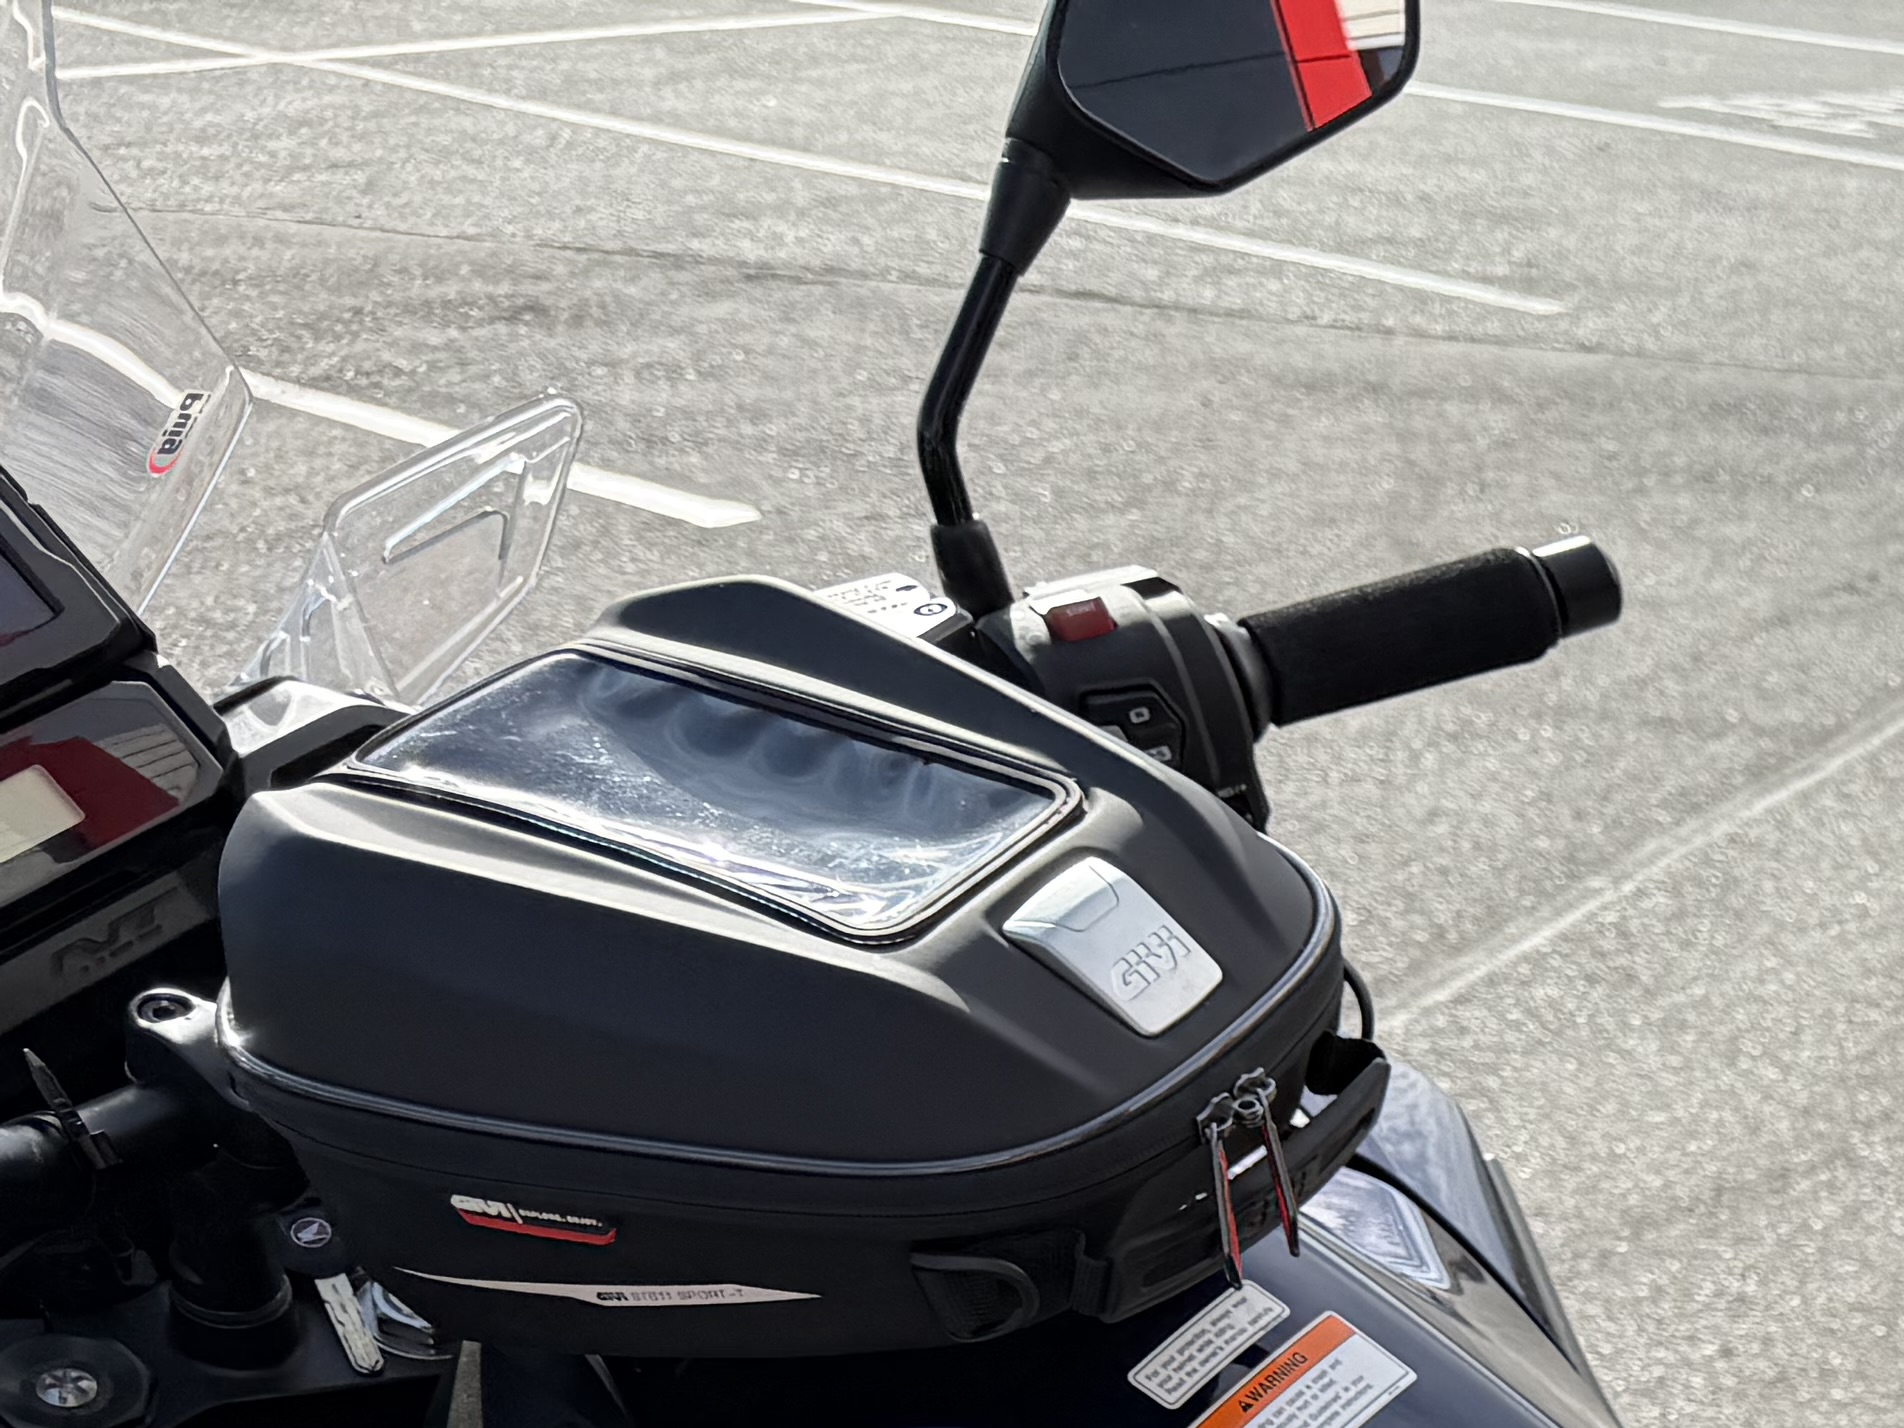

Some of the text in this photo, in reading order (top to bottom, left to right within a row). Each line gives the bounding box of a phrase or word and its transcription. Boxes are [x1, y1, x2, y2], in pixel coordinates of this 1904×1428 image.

[1111, 924, 1192, 1001] GIVI
[451, 1194, 512, 1219] GIVI
[1243, 1351, 1308, 1402] WARNING
